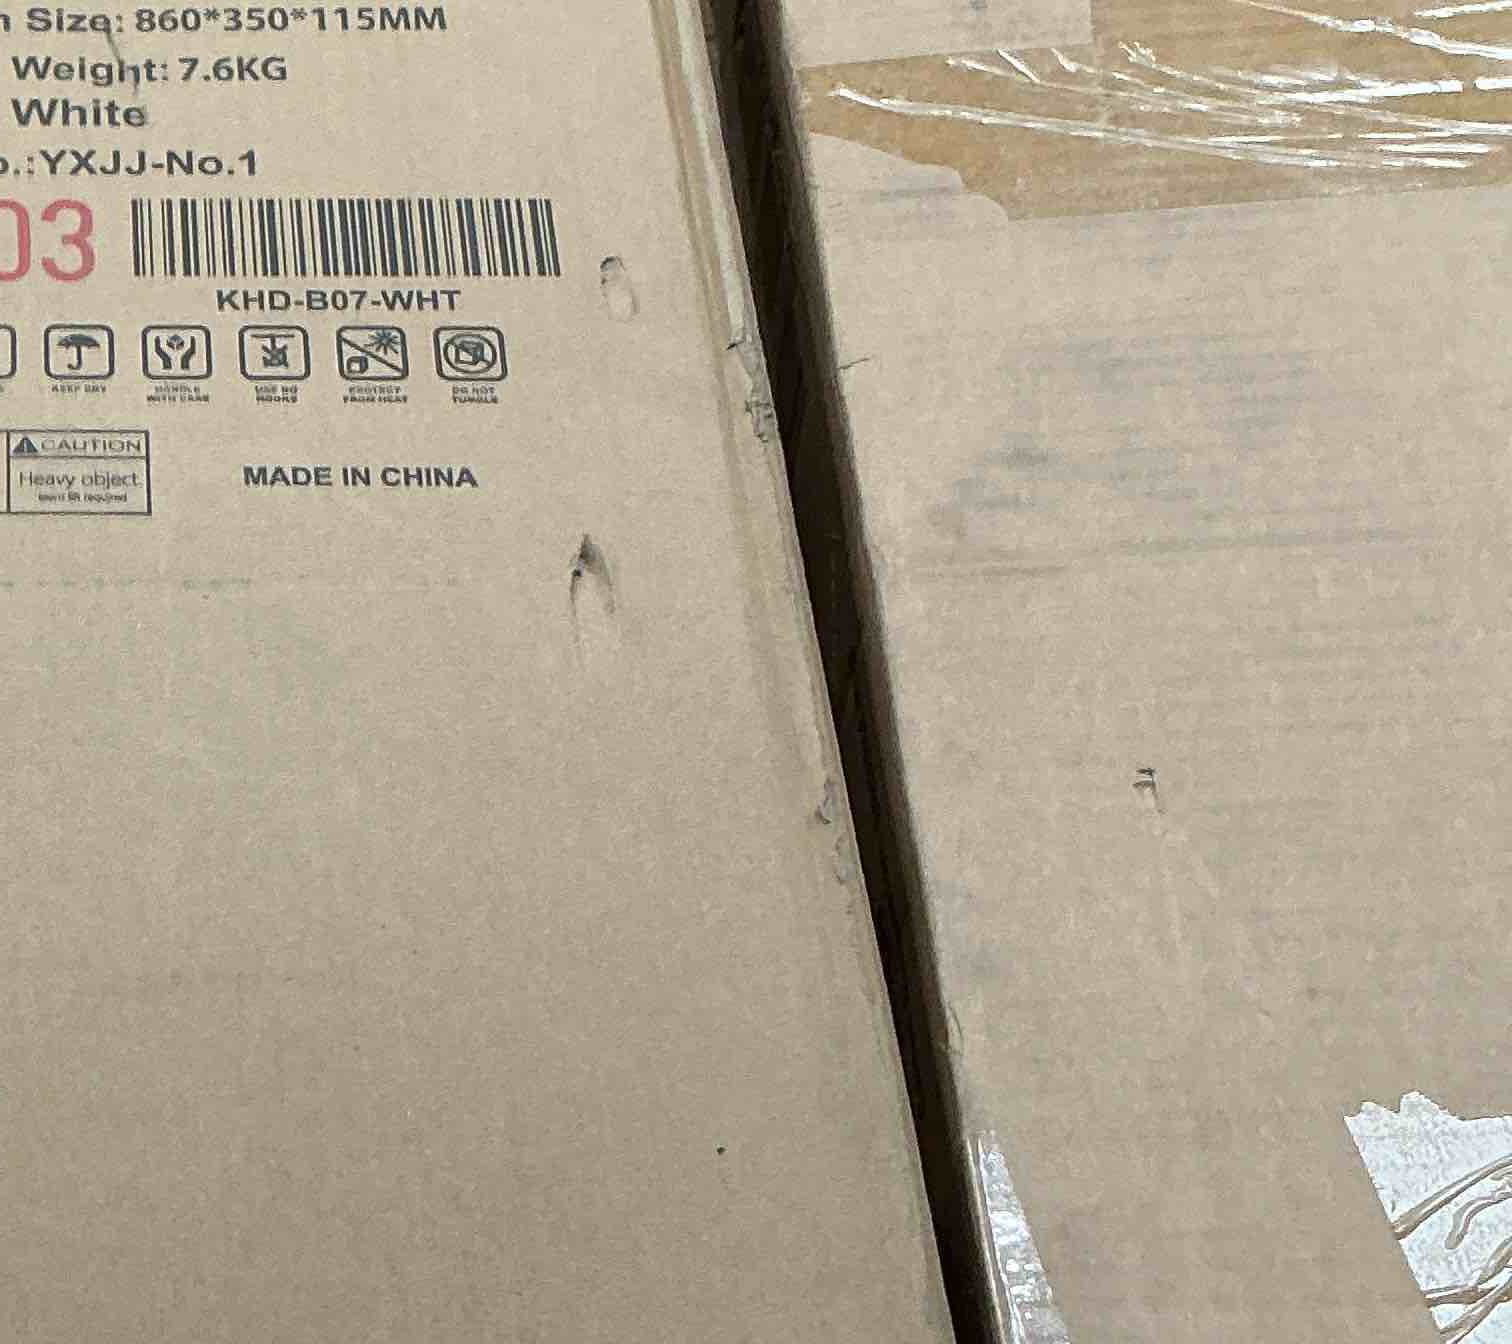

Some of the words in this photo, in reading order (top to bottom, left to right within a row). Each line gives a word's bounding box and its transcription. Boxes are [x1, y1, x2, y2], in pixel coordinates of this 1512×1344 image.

[26, 7, 124, 33] Size:
[10, 55, 169, 87] Weight:
[177, 55, 288, 81] 7.6KG
[10, 97, 146, 127] White
[215, 288, 462, 313] KHD-B07-WHT
[41, 438, 142, 453] CAUTION
[18, 470, 76, 491] Heavy
[242, 464, 333, 488] MADE
[342, 465, 371, 488] IN
[380, 465, 480, 489] CHINA
